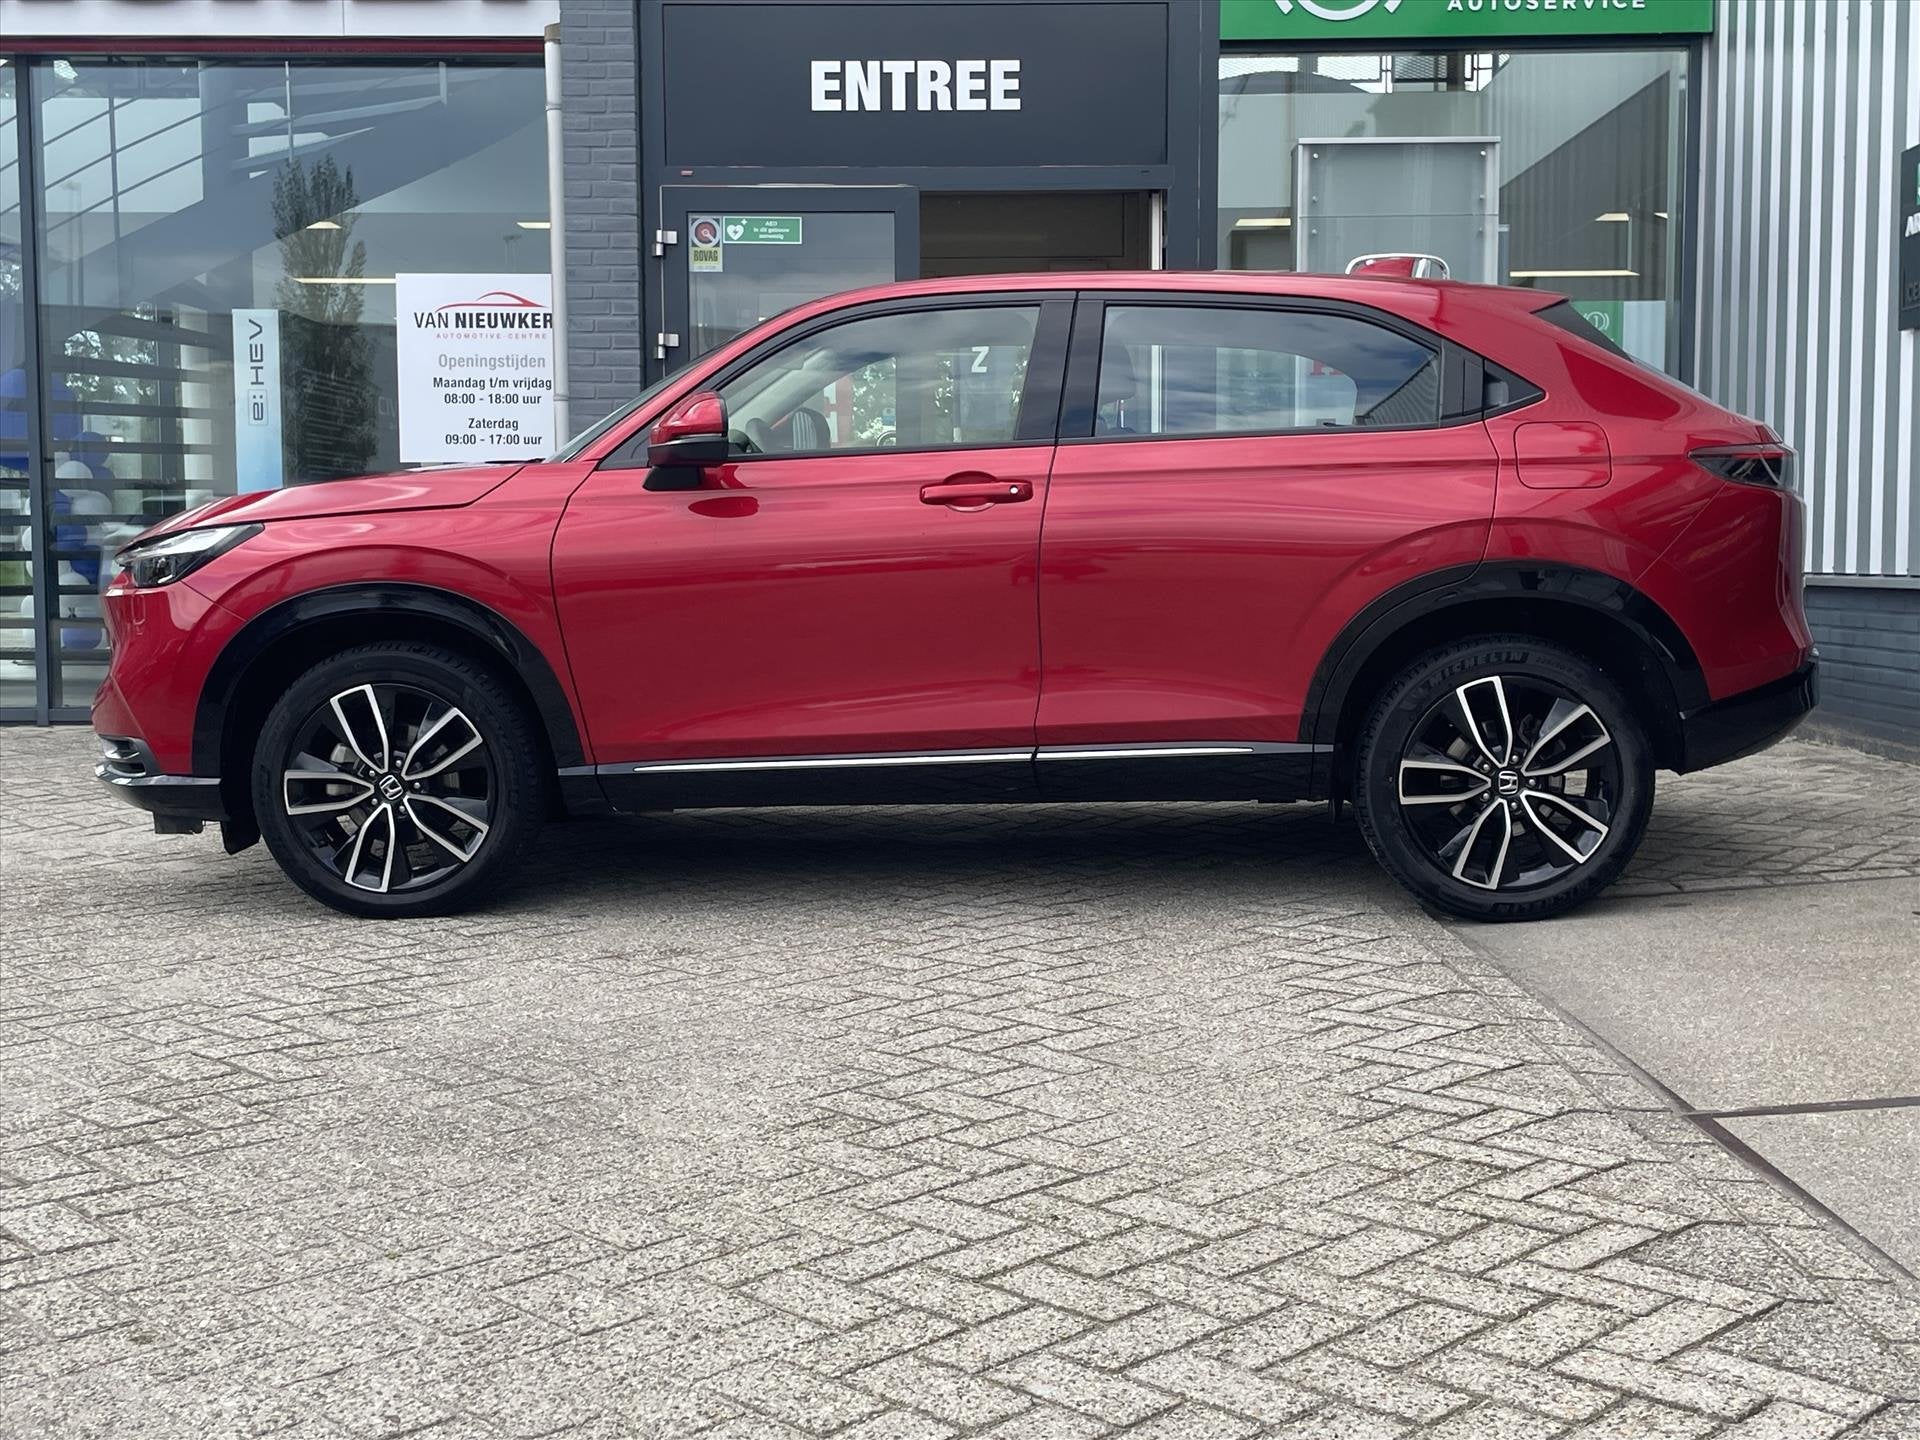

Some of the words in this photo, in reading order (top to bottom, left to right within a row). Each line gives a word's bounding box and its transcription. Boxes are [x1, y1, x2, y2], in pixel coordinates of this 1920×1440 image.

[1446, 0, 1647, 11] AUTOSERVICE
[810, 59, 1022, 111] ENTREE
[693, 249, 719, 262] BOVAG
[414, 311, 449, 329] VAN
[454, 311, 553, 329] NIEUWKER
[438, 353, 546, 371] Openingstijden
[433, 376, 486, 390] Maandag
[489, 376, 509, 388] t/m
[512, 376, 552, 390] vrijdag
[444, 393, 476, 404] 08:00
[488, 393, 519, 404] 18:00
[522, 395, 542, 404] uur
[468, 417, 519, 431] Zaterdag
[445, 434, 477, 445] 09:00
[489, 434, 520, 445] 17:00
[523, 436, 542, 445] uur
